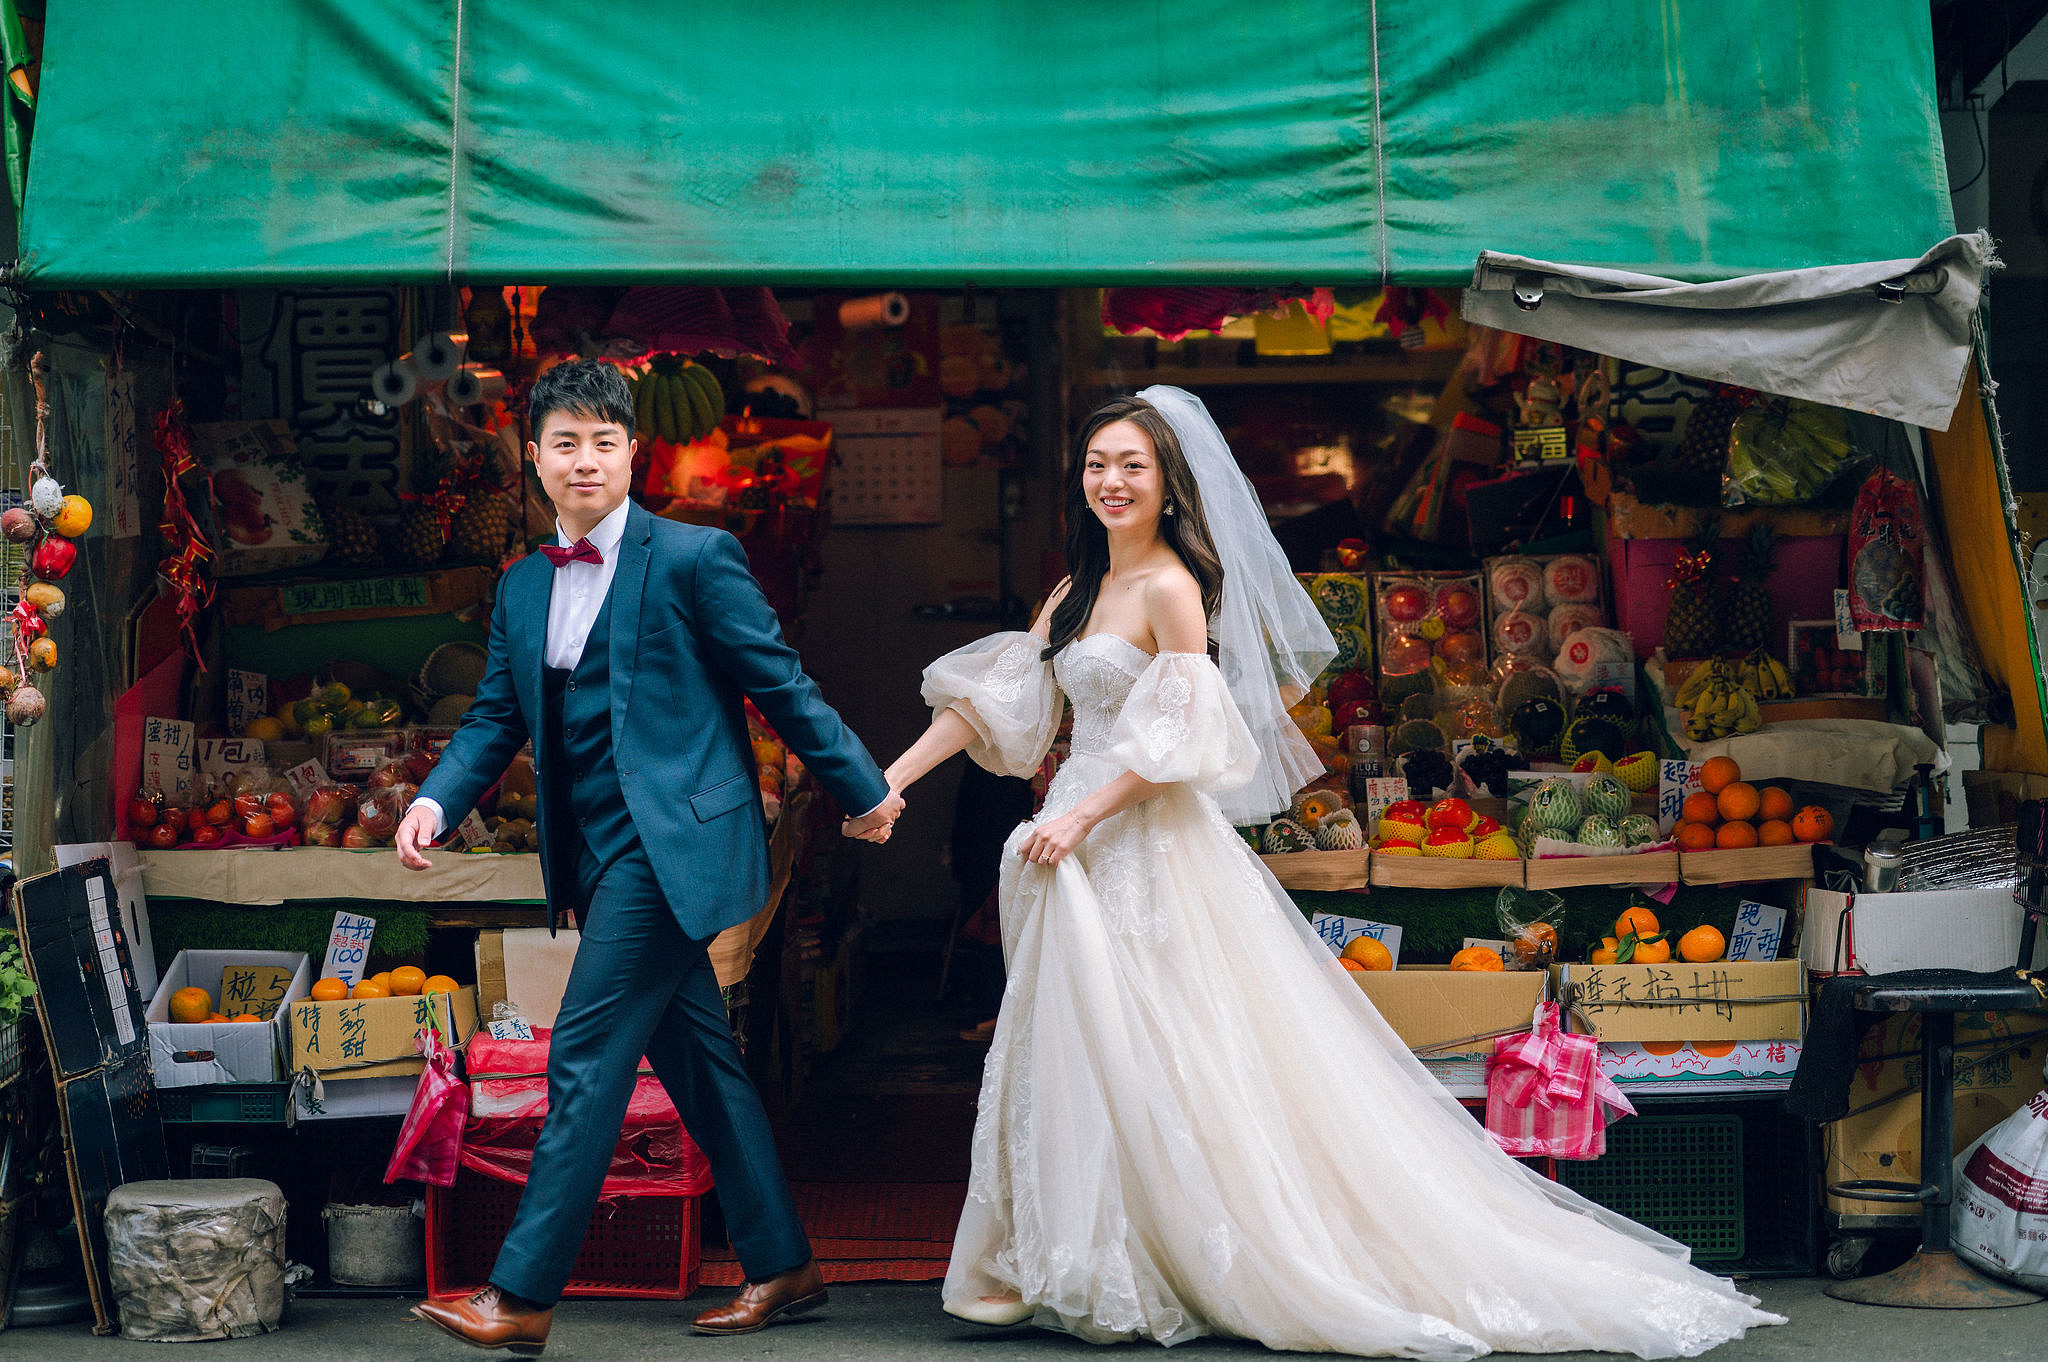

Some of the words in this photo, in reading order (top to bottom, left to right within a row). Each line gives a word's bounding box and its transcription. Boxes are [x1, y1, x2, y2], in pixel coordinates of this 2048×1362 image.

[292, 578, 423, 609] 現削甜鳳梨
[147, 720, 182, 747] 蜜柑
[331, 948, 363, 965] 100
[1766, 1043, 1787, 1063] 桔
